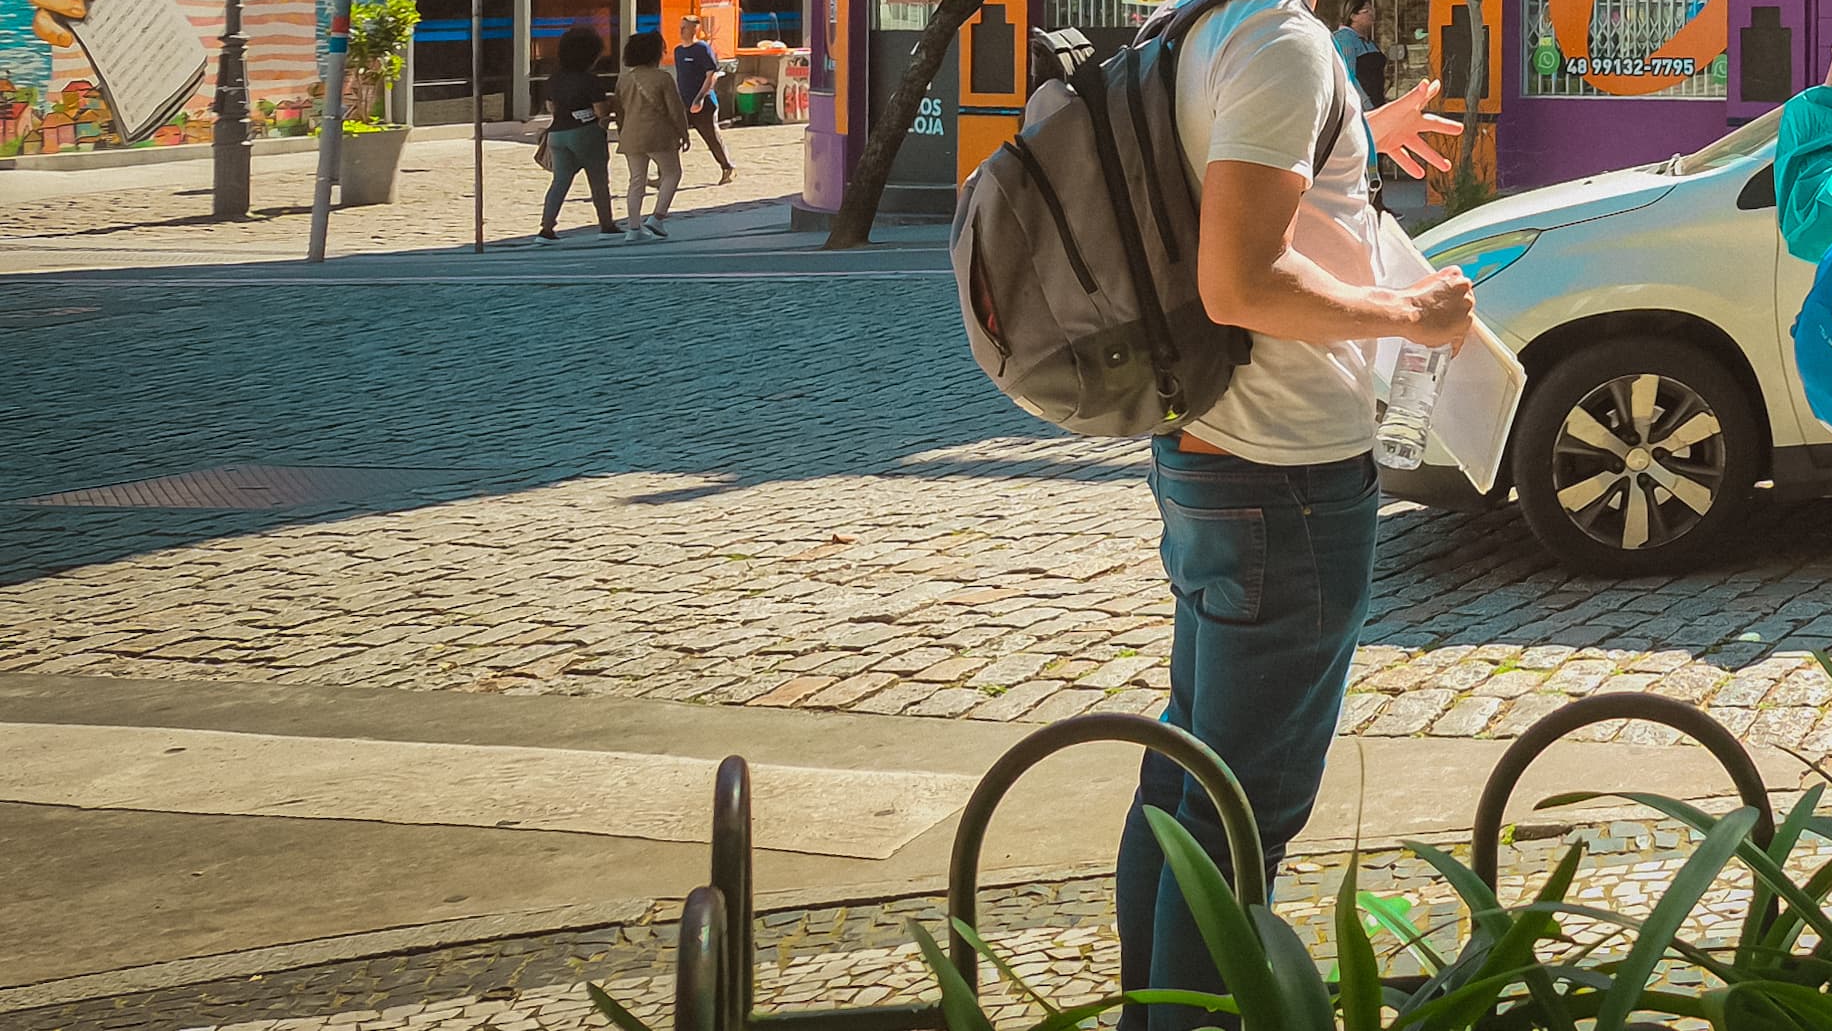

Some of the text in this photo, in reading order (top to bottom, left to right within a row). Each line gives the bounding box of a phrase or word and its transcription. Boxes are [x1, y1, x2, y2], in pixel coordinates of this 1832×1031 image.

[1566, 58, 1694, 76] 48 99132-7795
[917, 97, 942, 116] OS
